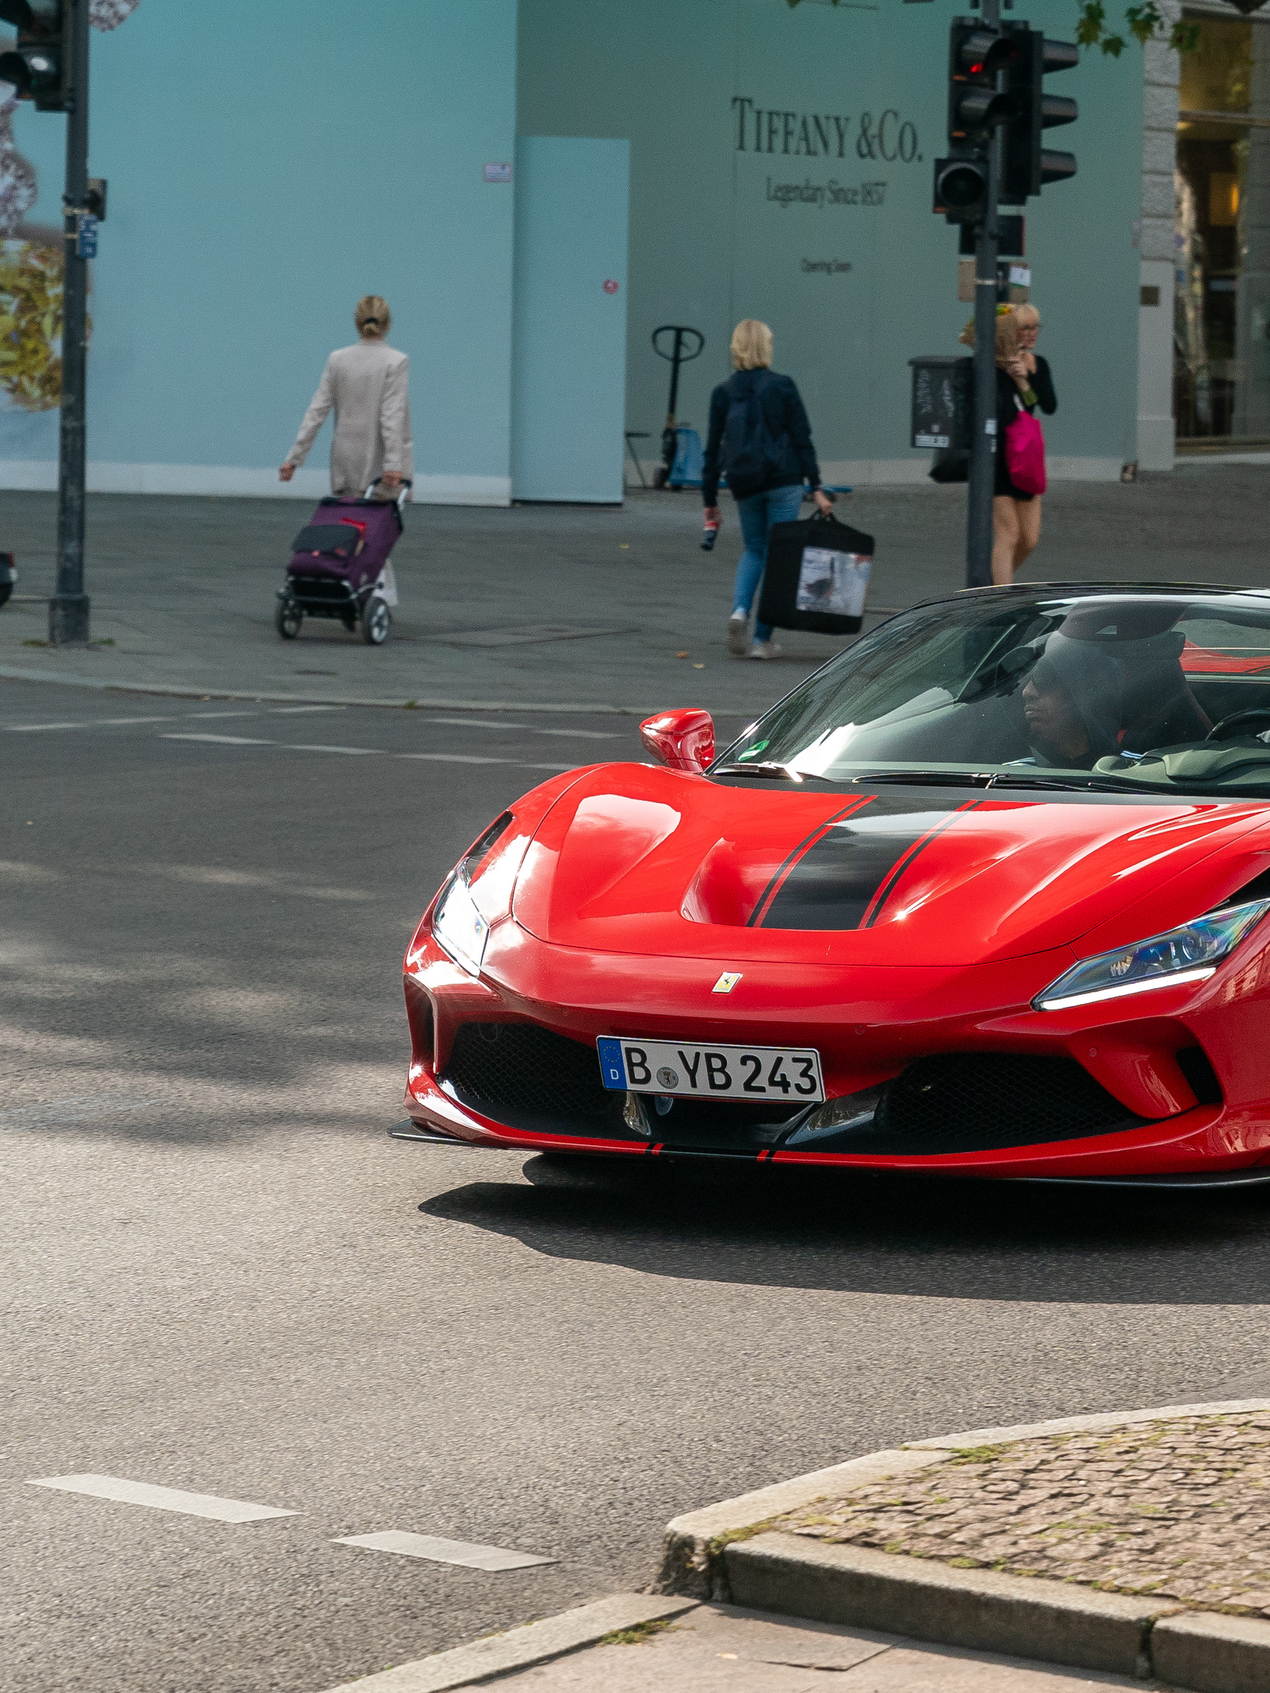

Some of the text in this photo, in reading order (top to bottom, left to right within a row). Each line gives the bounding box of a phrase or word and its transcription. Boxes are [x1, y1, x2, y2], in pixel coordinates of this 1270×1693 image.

[731, 96, 850, 158] TIFFANY
[610, 1047, 817, 1095] D B YB 243
